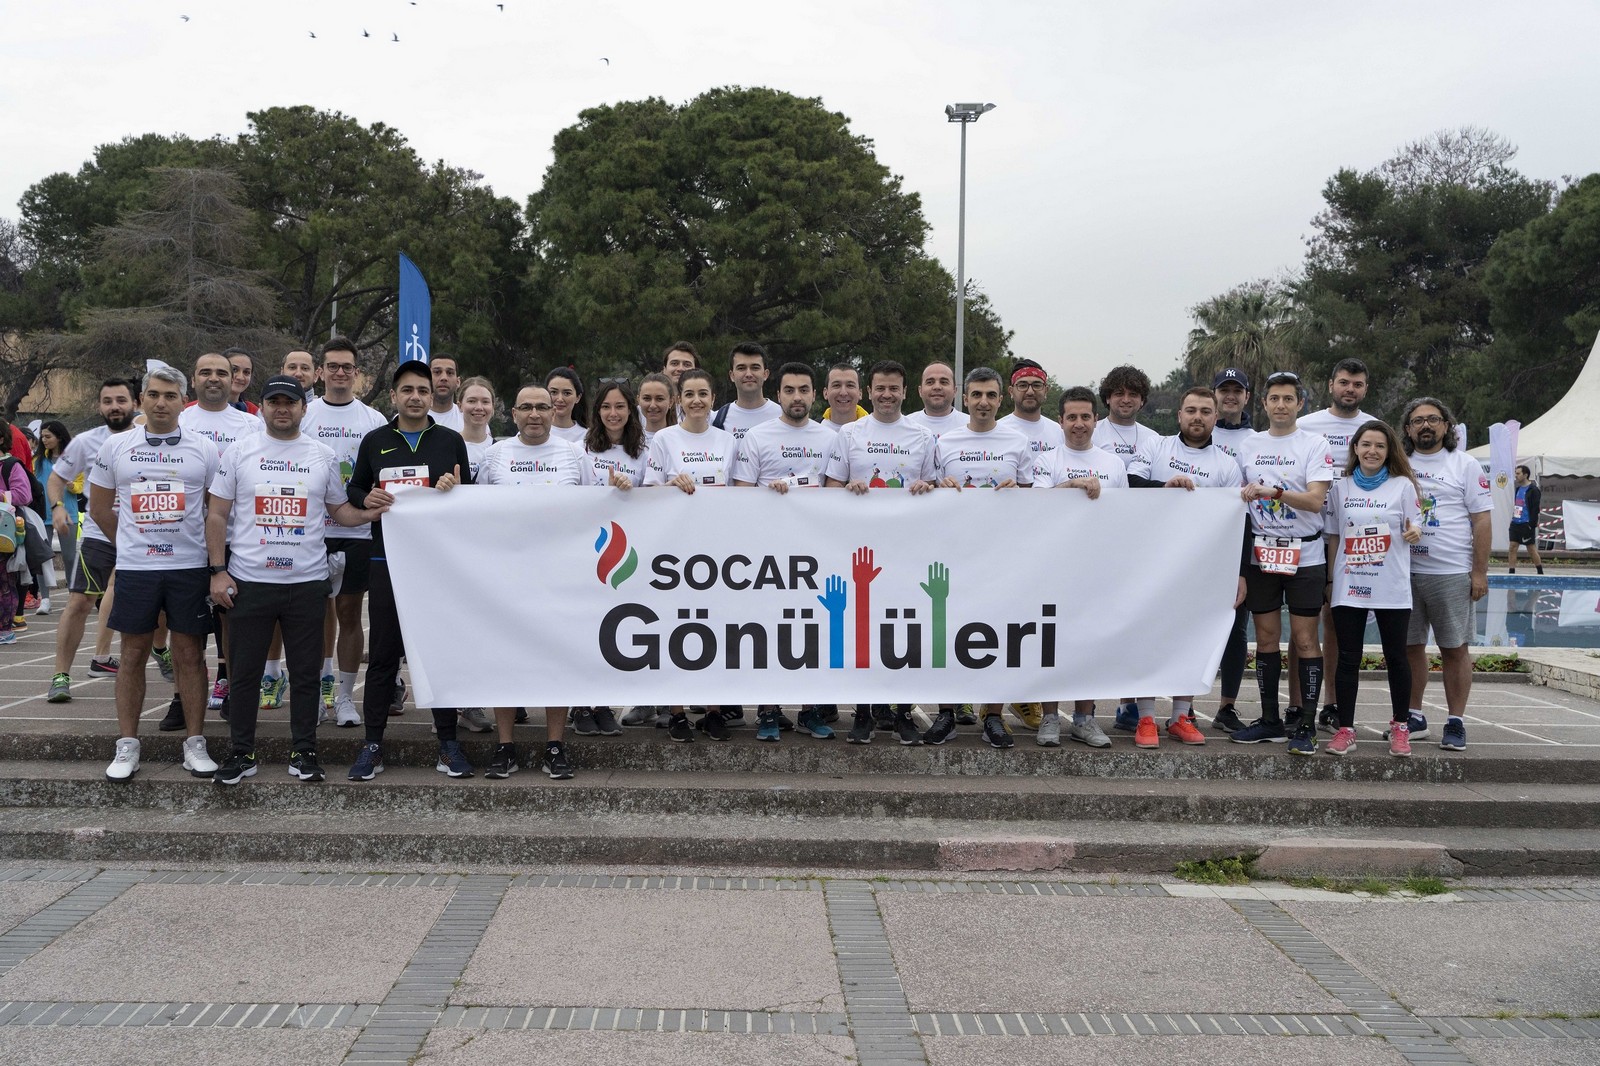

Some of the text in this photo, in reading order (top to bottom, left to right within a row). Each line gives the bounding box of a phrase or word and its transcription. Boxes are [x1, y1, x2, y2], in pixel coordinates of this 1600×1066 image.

[318, 427, 362, 438] Gönüllüleri
[782, 447, 822, 458] Gönüllüleri
[867, 443, 910, 455] Gönüllüleri
[130, 452, 183, 463] Gönüllüleri
[960, 451, 1004, 462] Gönüllüleri
[1255, 456, 1295, 466] Gönüllüleri
[260, 461, 310, 473] Gönüllüleri
[510, 461, 557, 472] Gönüllüleri
[594, 462, 636, 475] Gönllüleri
[140, 494, 178, 512] 2098
[263, 498, 301, 515] 3065
[1344, 499, 1387, 509] Gönüllüleri
[1352, 537, 1385, 554] 4485
[1260, 548, 1294, 565] 3919
[649, 553, 819, 590] SOCAR
[599, 557, 1057, 671] Gönüllüleri
